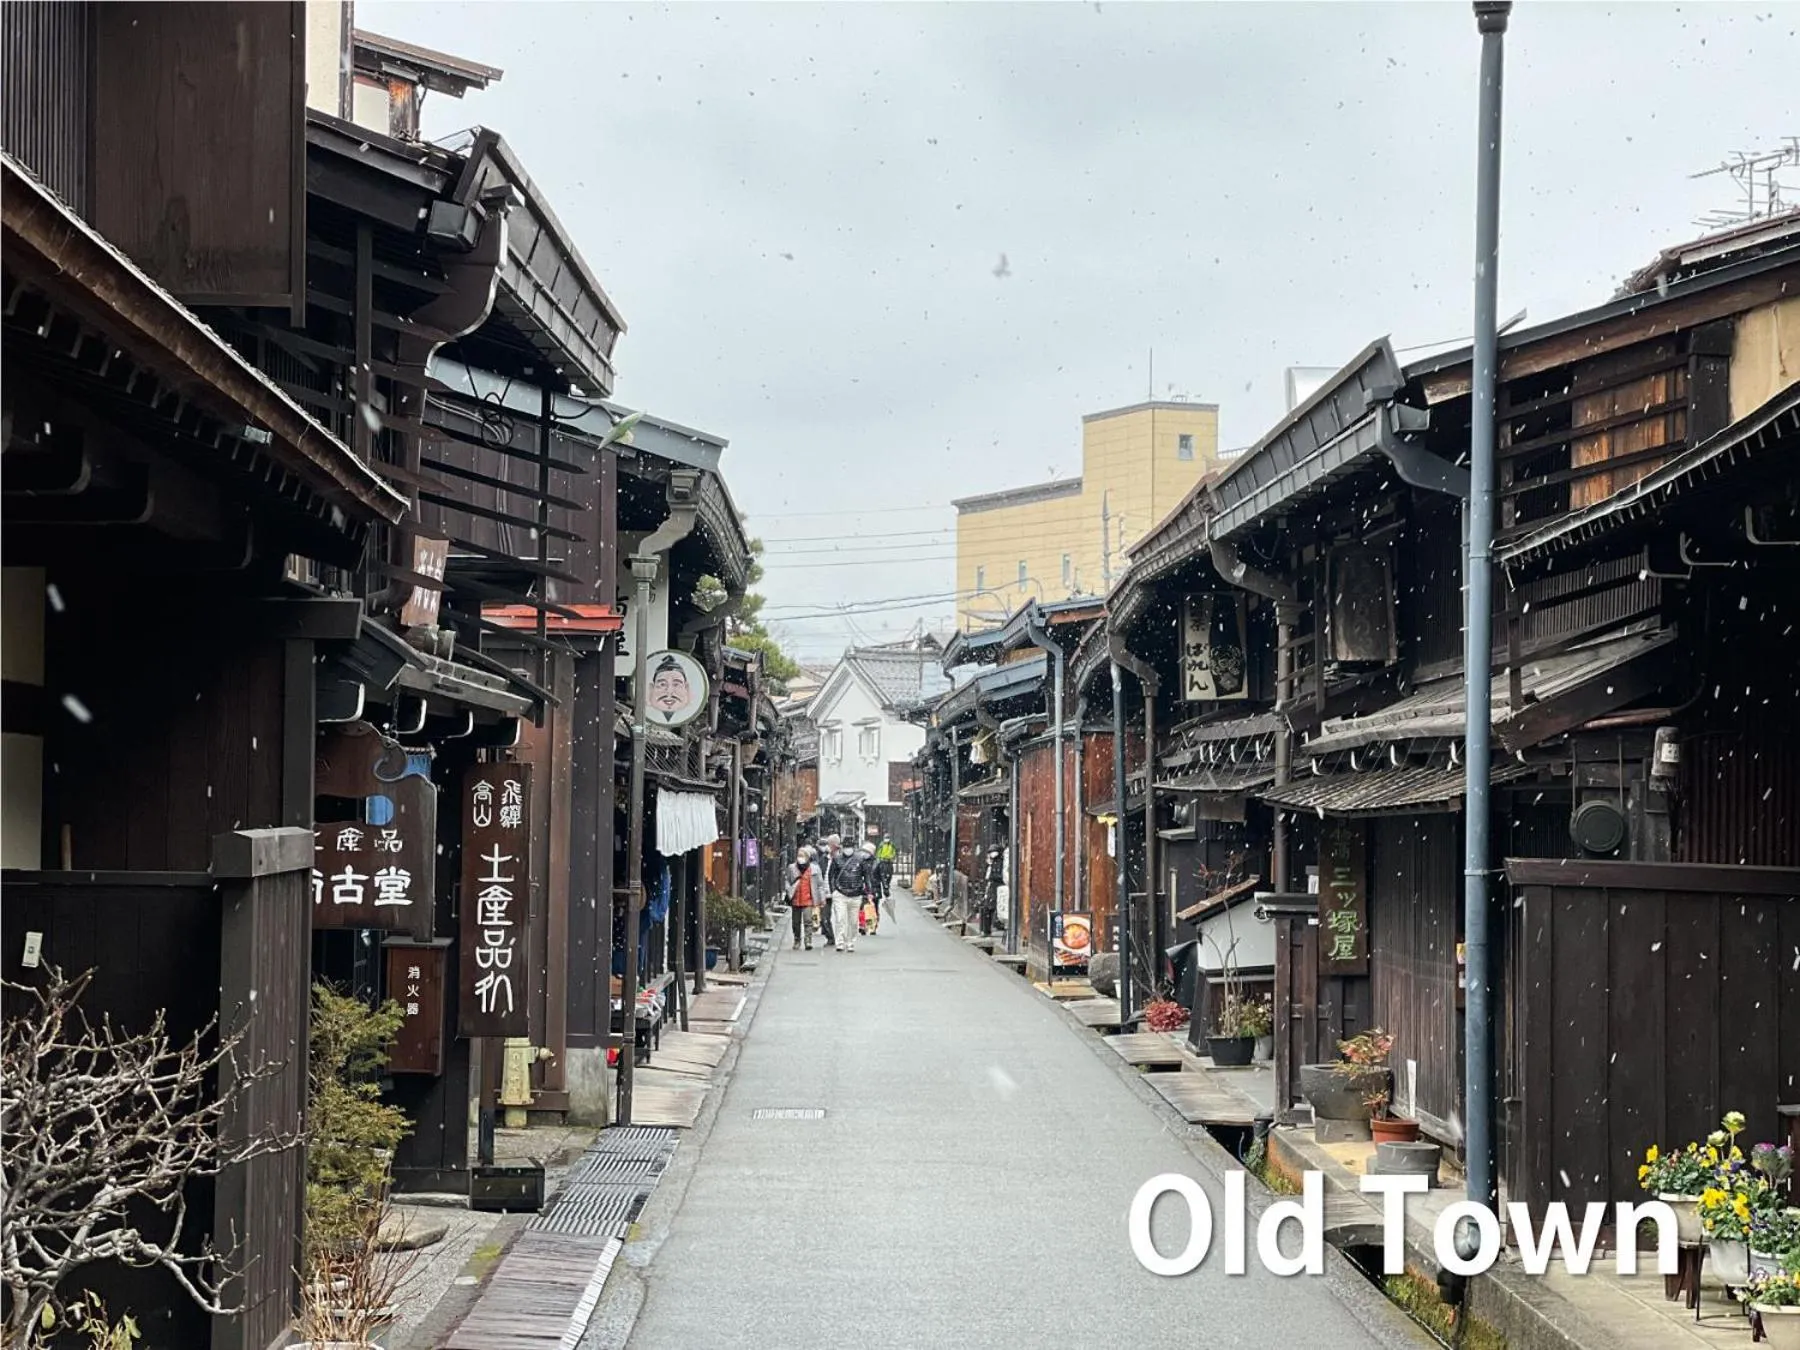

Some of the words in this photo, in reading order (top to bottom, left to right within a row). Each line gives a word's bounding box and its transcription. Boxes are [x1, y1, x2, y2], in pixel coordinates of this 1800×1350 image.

[1187, 643, 1209, 692] ばれん
[471, 779, 495, 828] 高山
[404, 965, 421, 1016] 消火器
